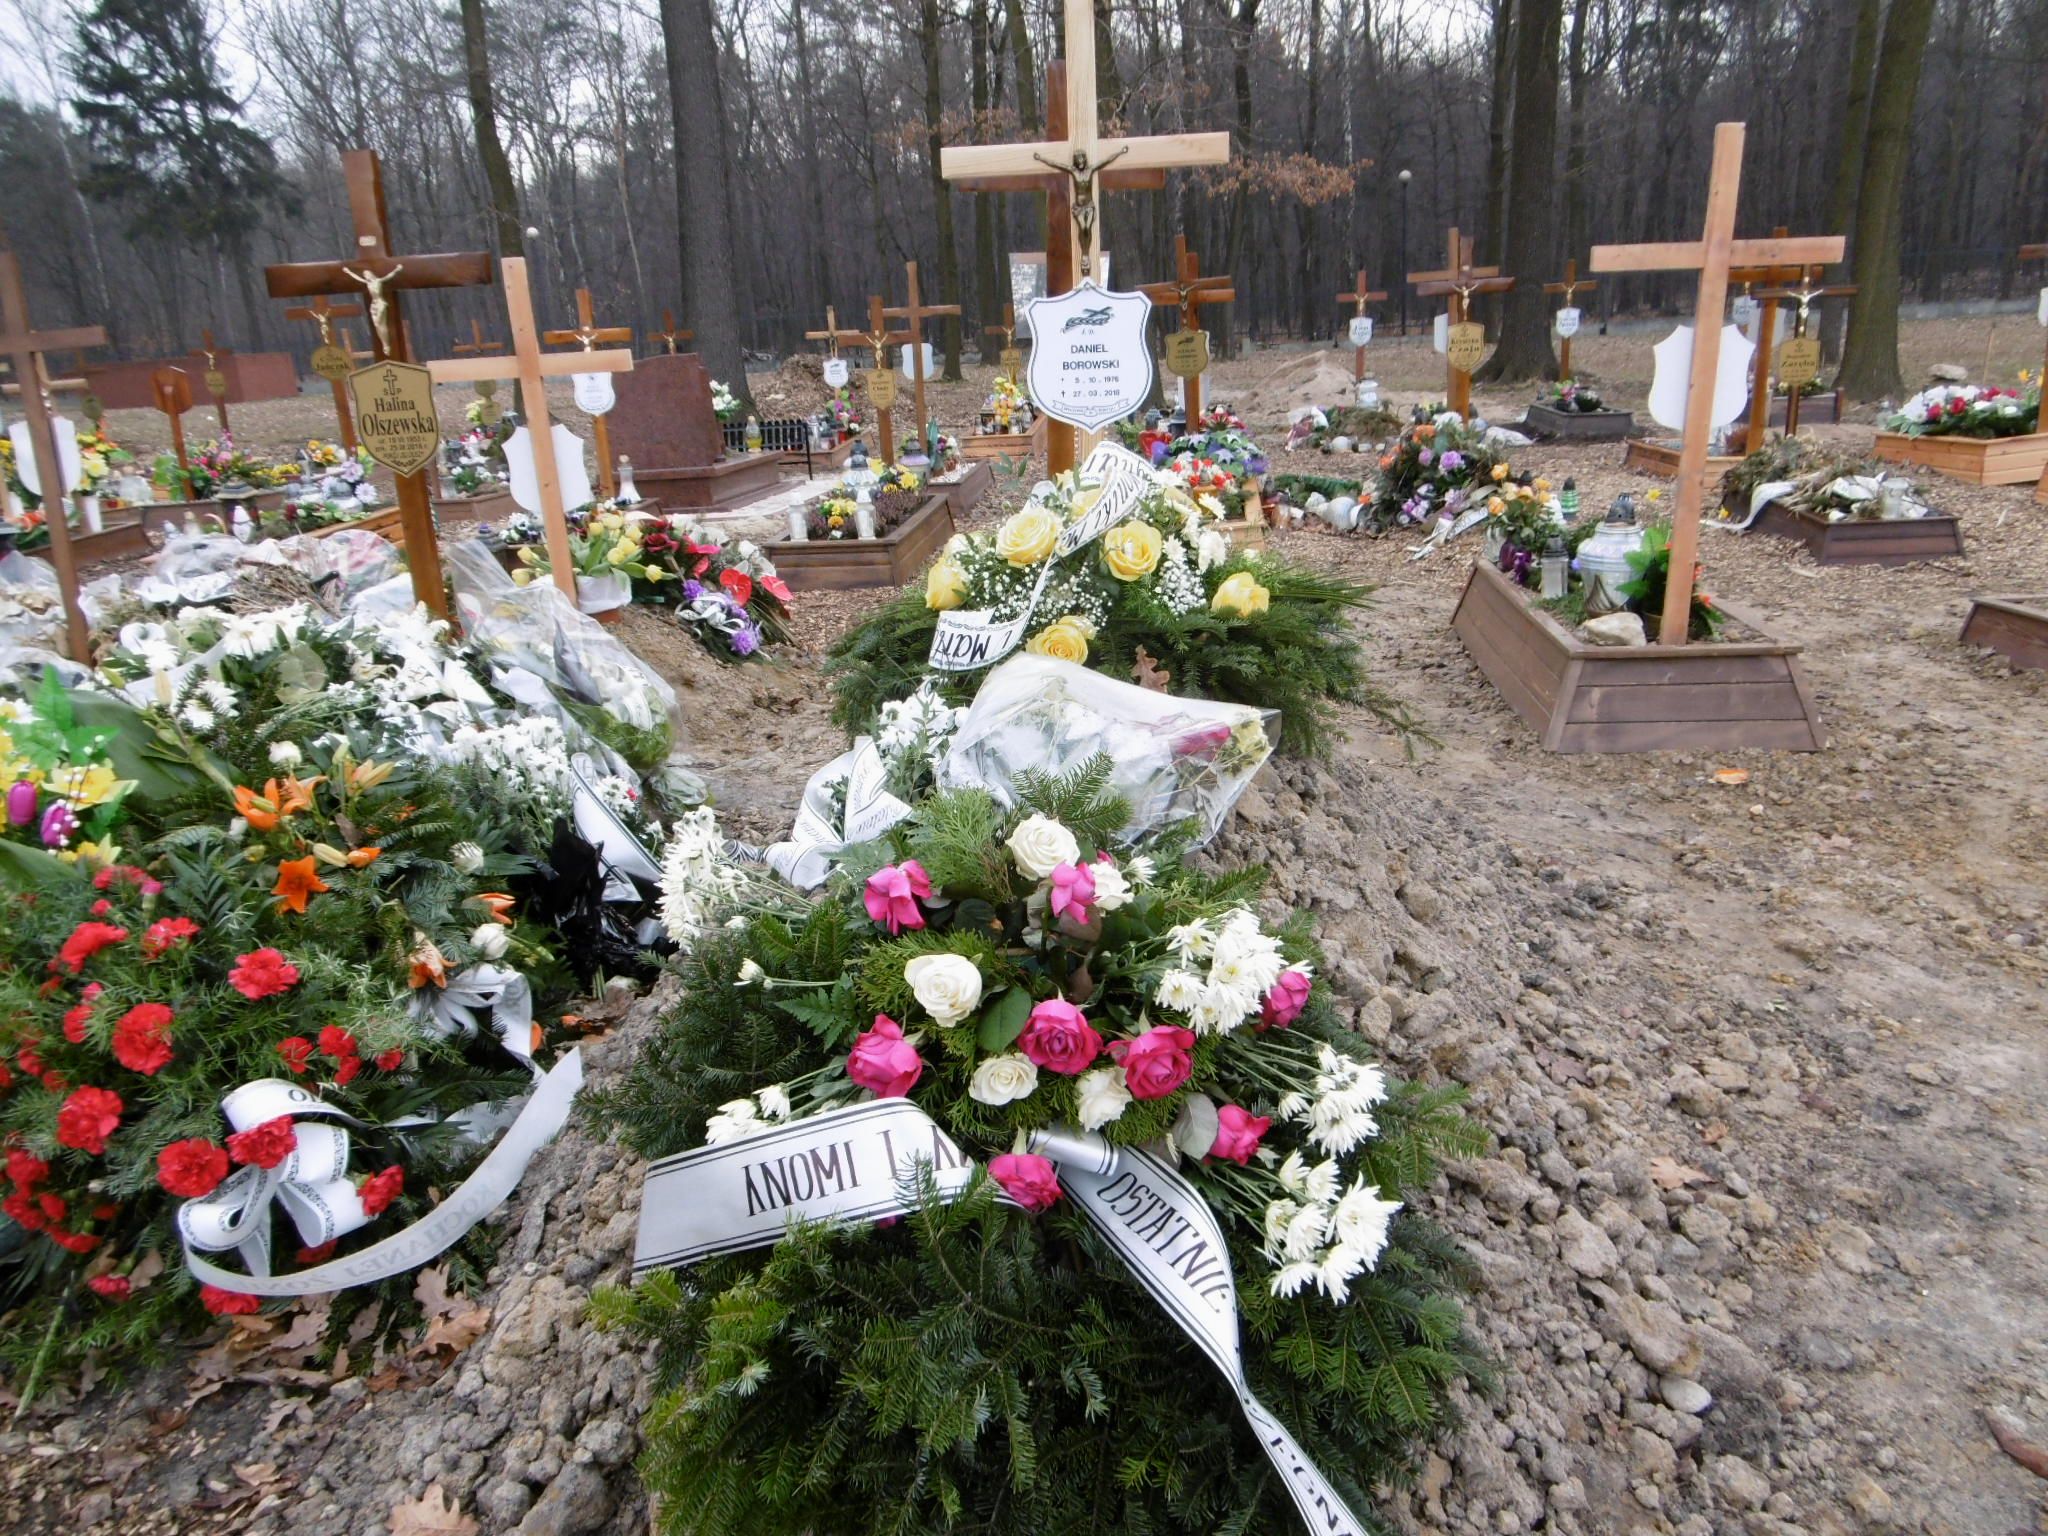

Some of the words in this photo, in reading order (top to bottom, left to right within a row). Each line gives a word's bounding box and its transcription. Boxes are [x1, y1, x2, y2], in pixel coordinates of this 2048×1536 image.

[1070, 344, 1108, 354] DANIEL
[1062, 359, 1120, 370] BOROWSKI
[374, 397, 416, 413] Halina
[361, 410, 435, 437] Olszewska
[1096, 1171, 1231, 1314] OSTATNIE
